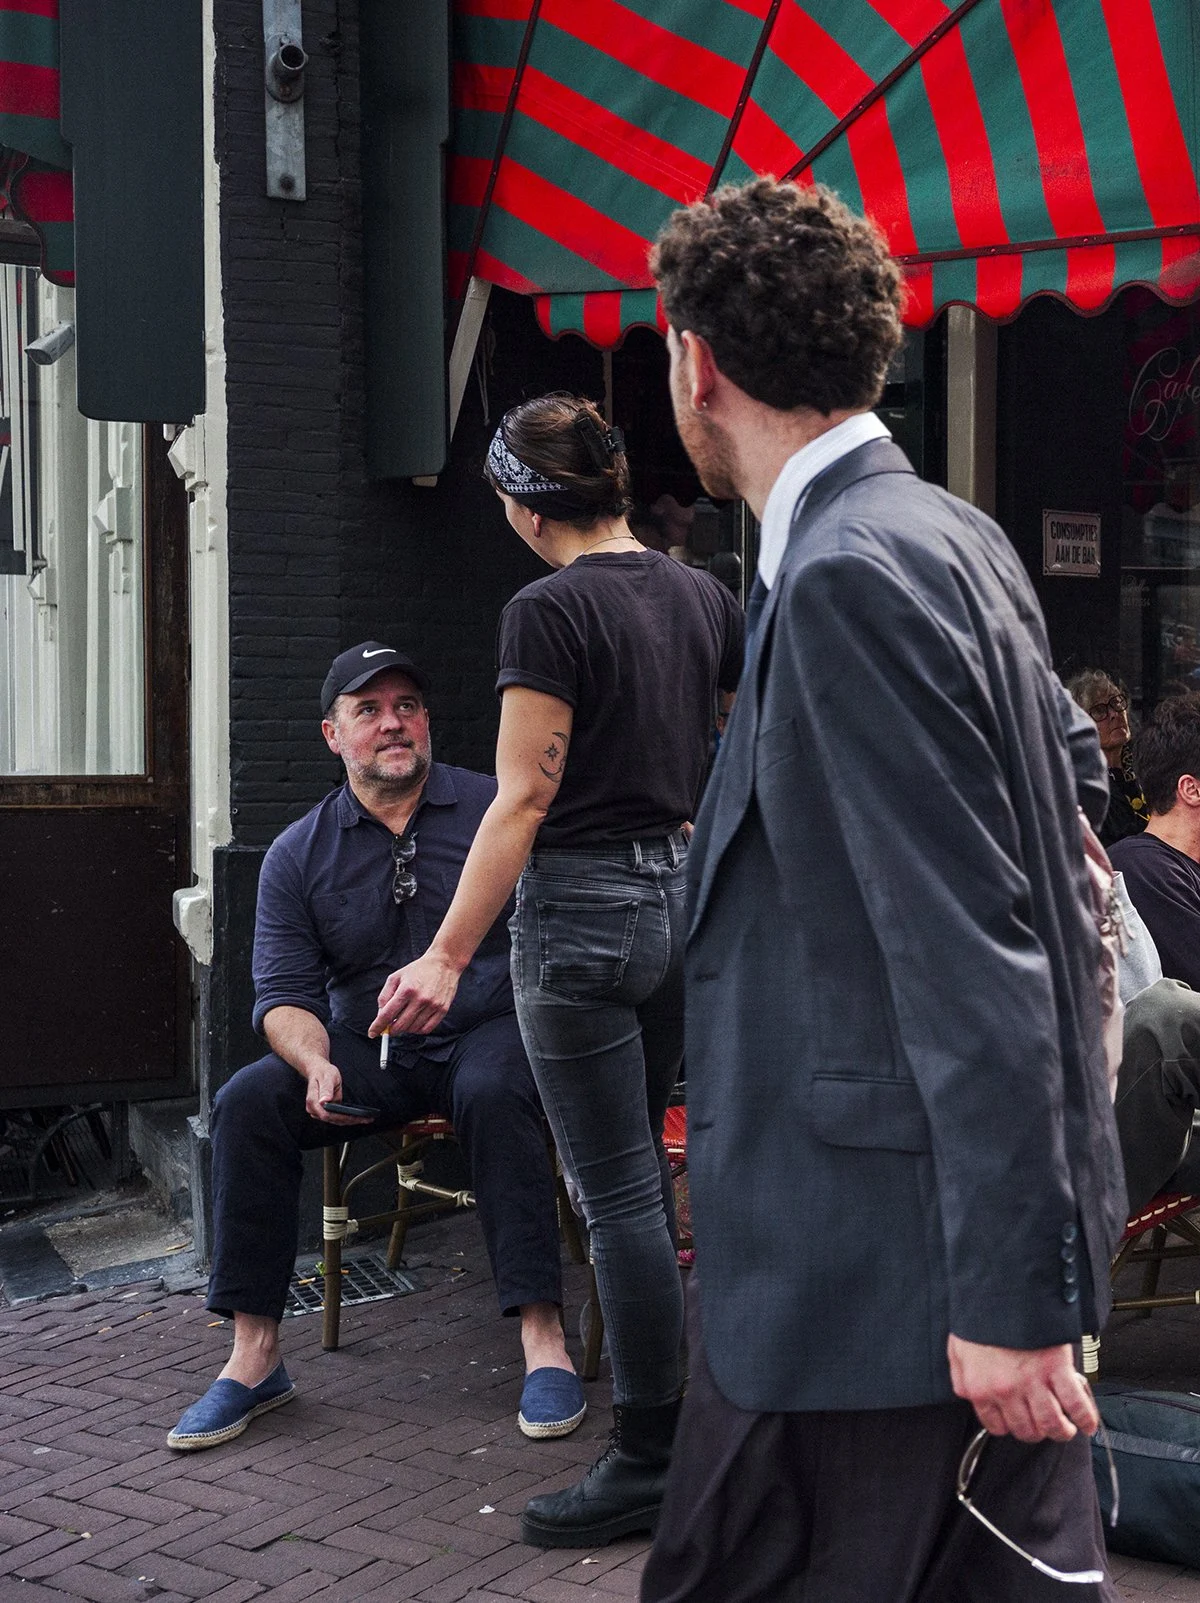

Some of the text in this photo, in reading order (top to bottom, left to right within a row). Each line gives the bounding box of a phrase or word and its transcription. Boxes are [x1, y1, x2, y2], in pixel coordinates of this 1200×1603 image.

[1050, 521, 1097, 541] CONSUMPTIES
[1055, 545, 1096, 565] AAN DE BAR
